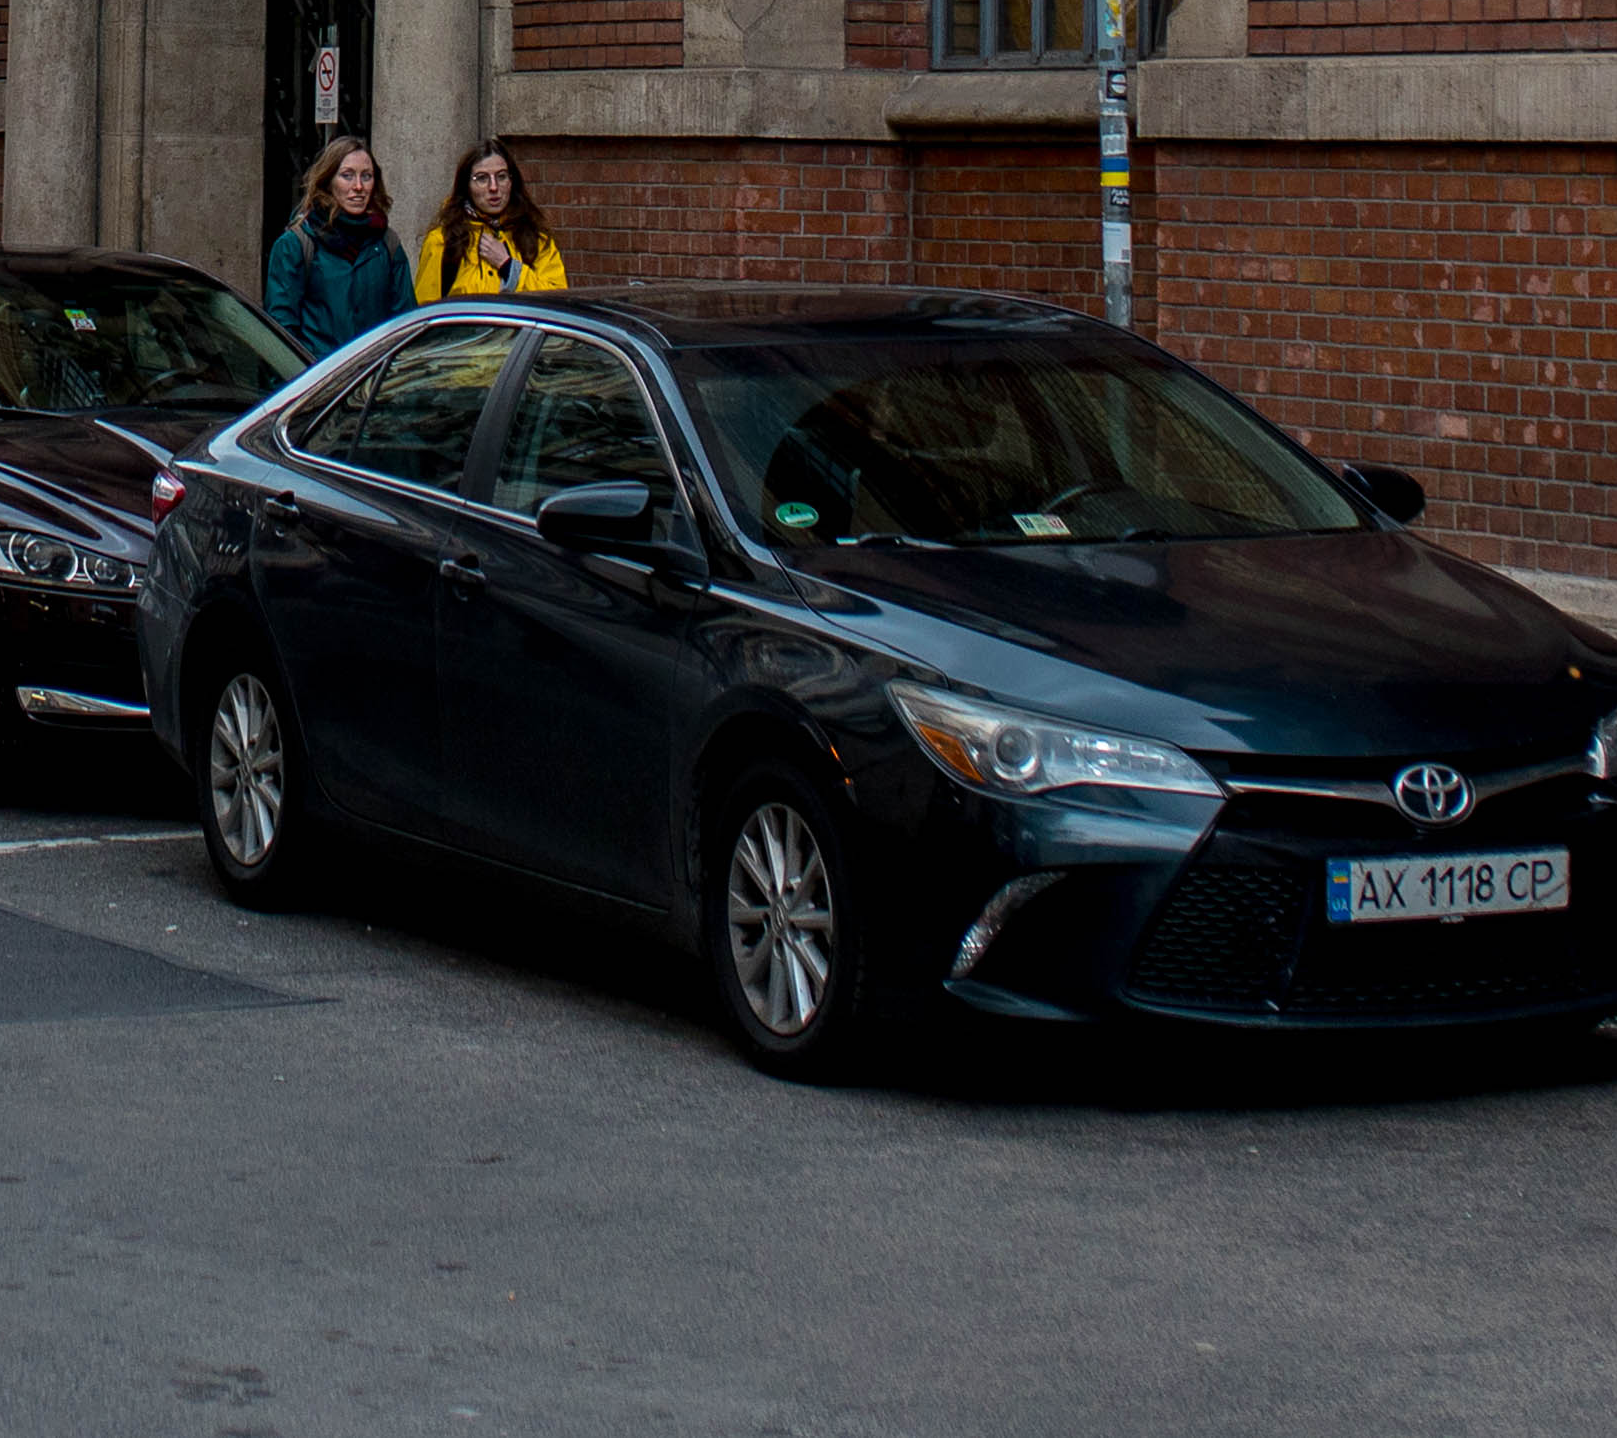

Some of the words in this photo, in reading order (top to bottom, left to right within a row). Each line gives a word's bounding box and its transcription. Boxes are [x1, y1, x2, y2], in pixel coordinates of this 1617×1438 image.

[1357, 865, 1409, 910] AX
[1420, 862, 1495, 907] 1118
[1506, 859, 1554, 901] CP
